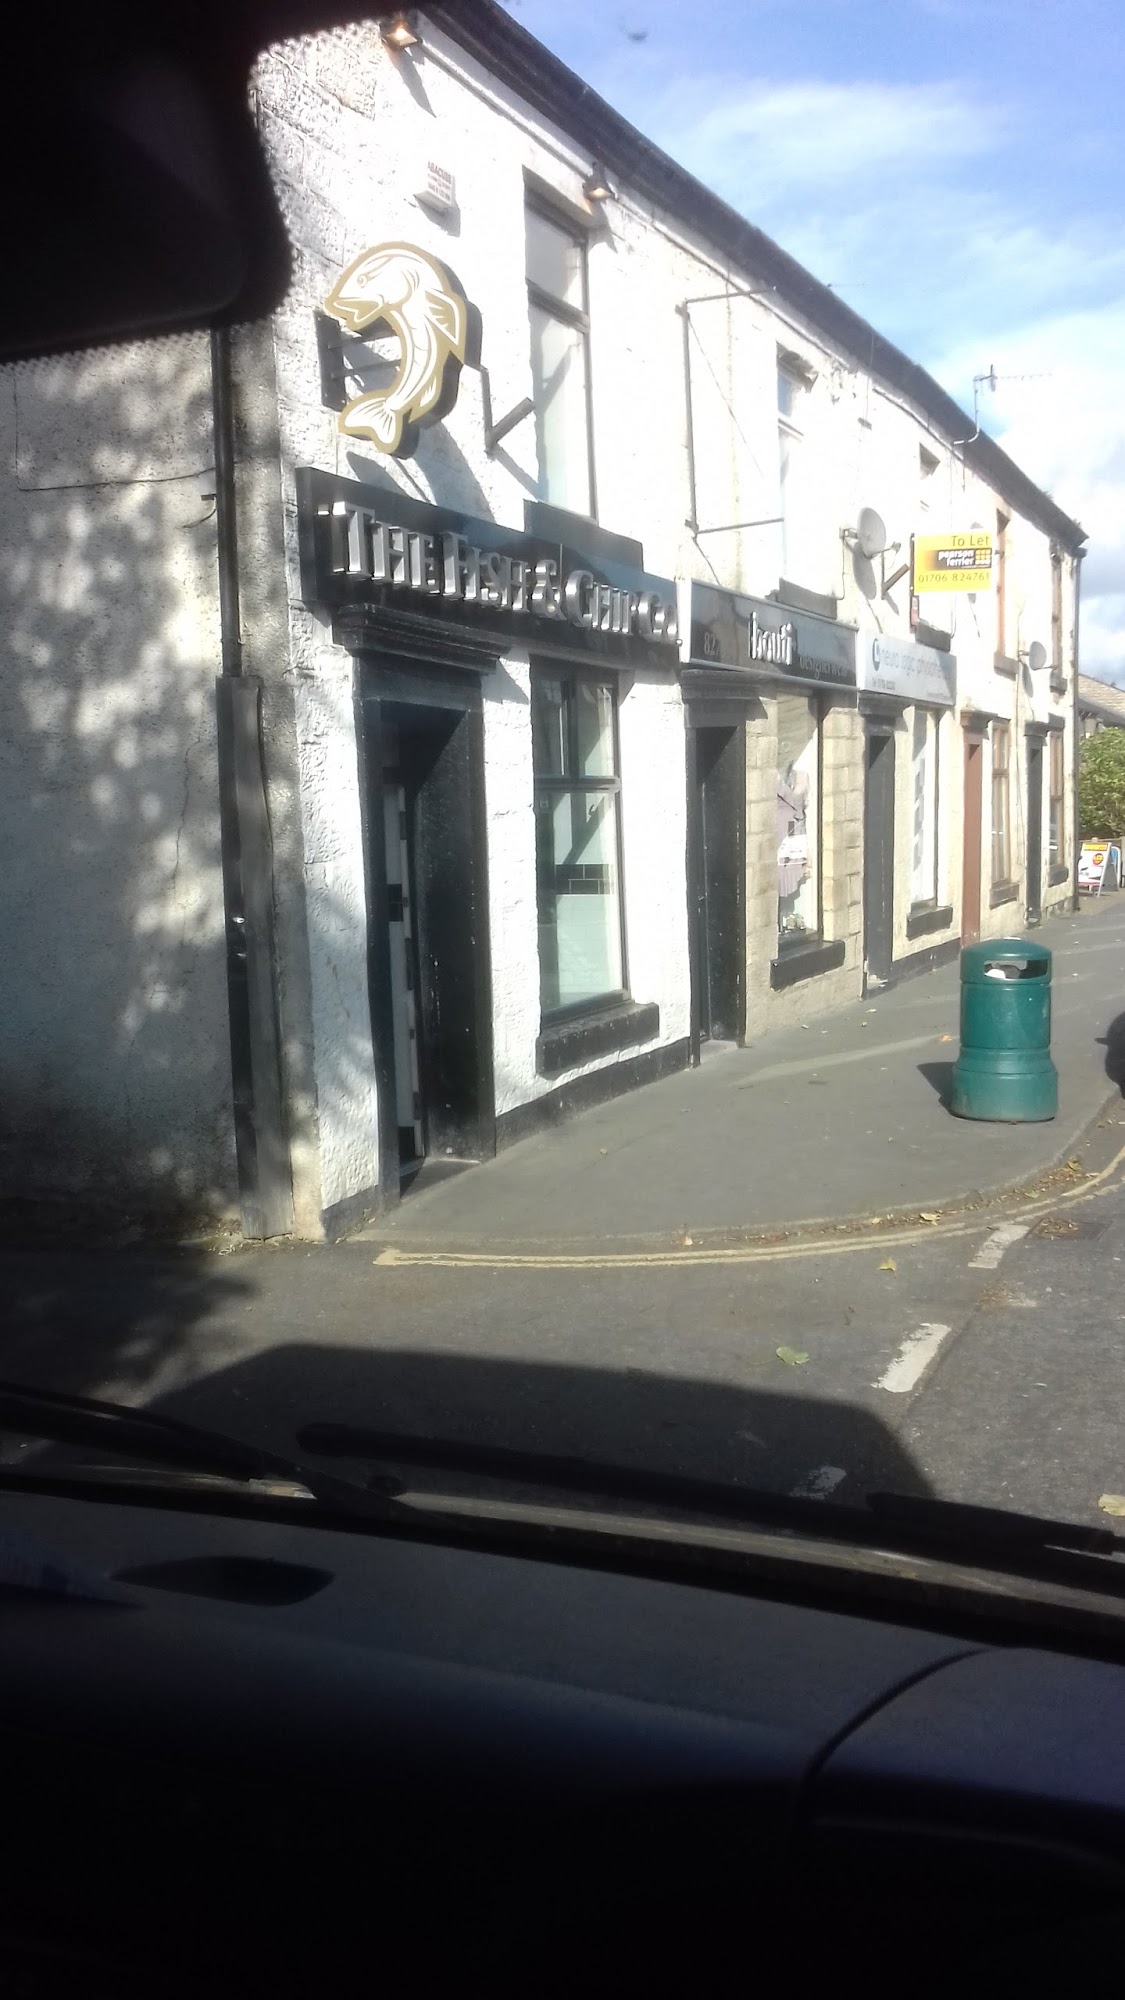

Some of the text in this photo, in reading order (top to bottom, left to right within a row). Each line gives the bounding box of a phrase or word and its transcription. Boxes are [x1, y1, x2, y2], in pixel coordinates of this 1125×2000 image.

[952, 534, 989, 547] To Let
[332, 500, 441, 595] THE
[441, 531, 532, 613] FISH
[532, 559, 567, 622] &
[937, 549, 975, 561] pearson
[918, 571, 990, 583] 01706 824761
